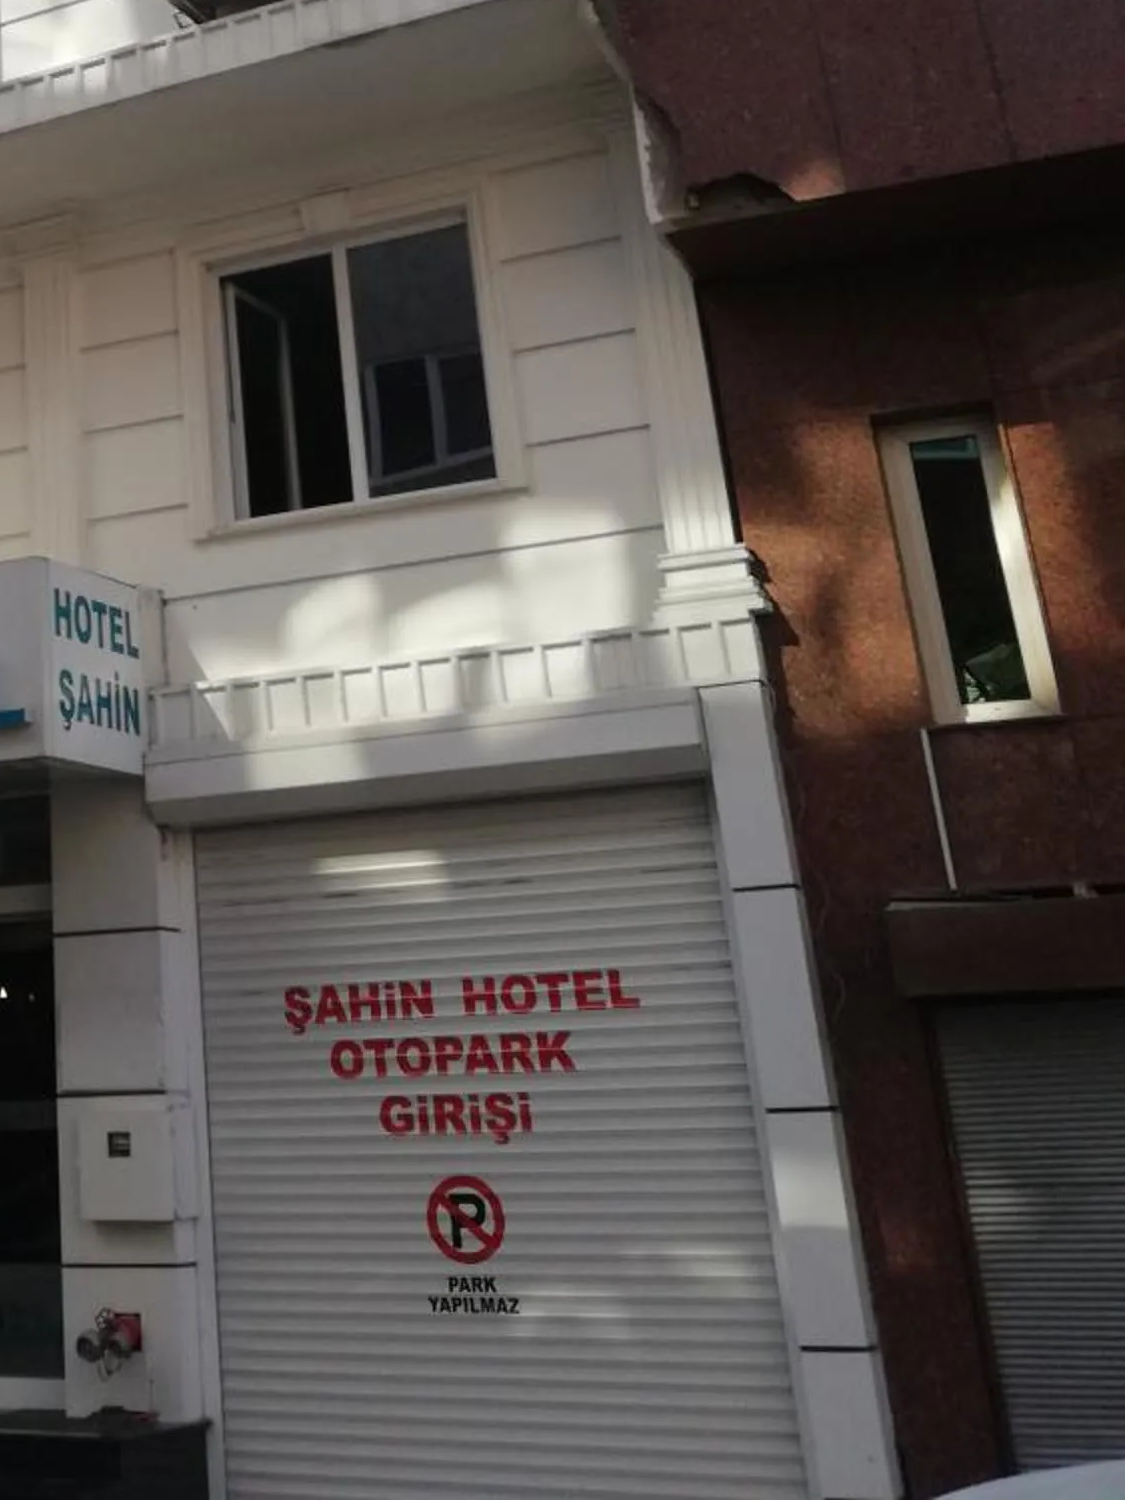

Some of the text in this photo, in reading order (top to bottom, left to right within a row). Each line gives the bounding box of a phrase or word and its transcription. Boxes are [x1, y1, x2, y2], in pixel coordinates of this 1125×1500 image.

[54, 588, 140, 660] HOTEL
[462, 968, 641, 1016] HOTEL
[330, 1030, 577, 1079] OTOPARK
[428, 1296, 520, 1315] YAPILMAZ
[448, 1276, 497, 1293] PARK
